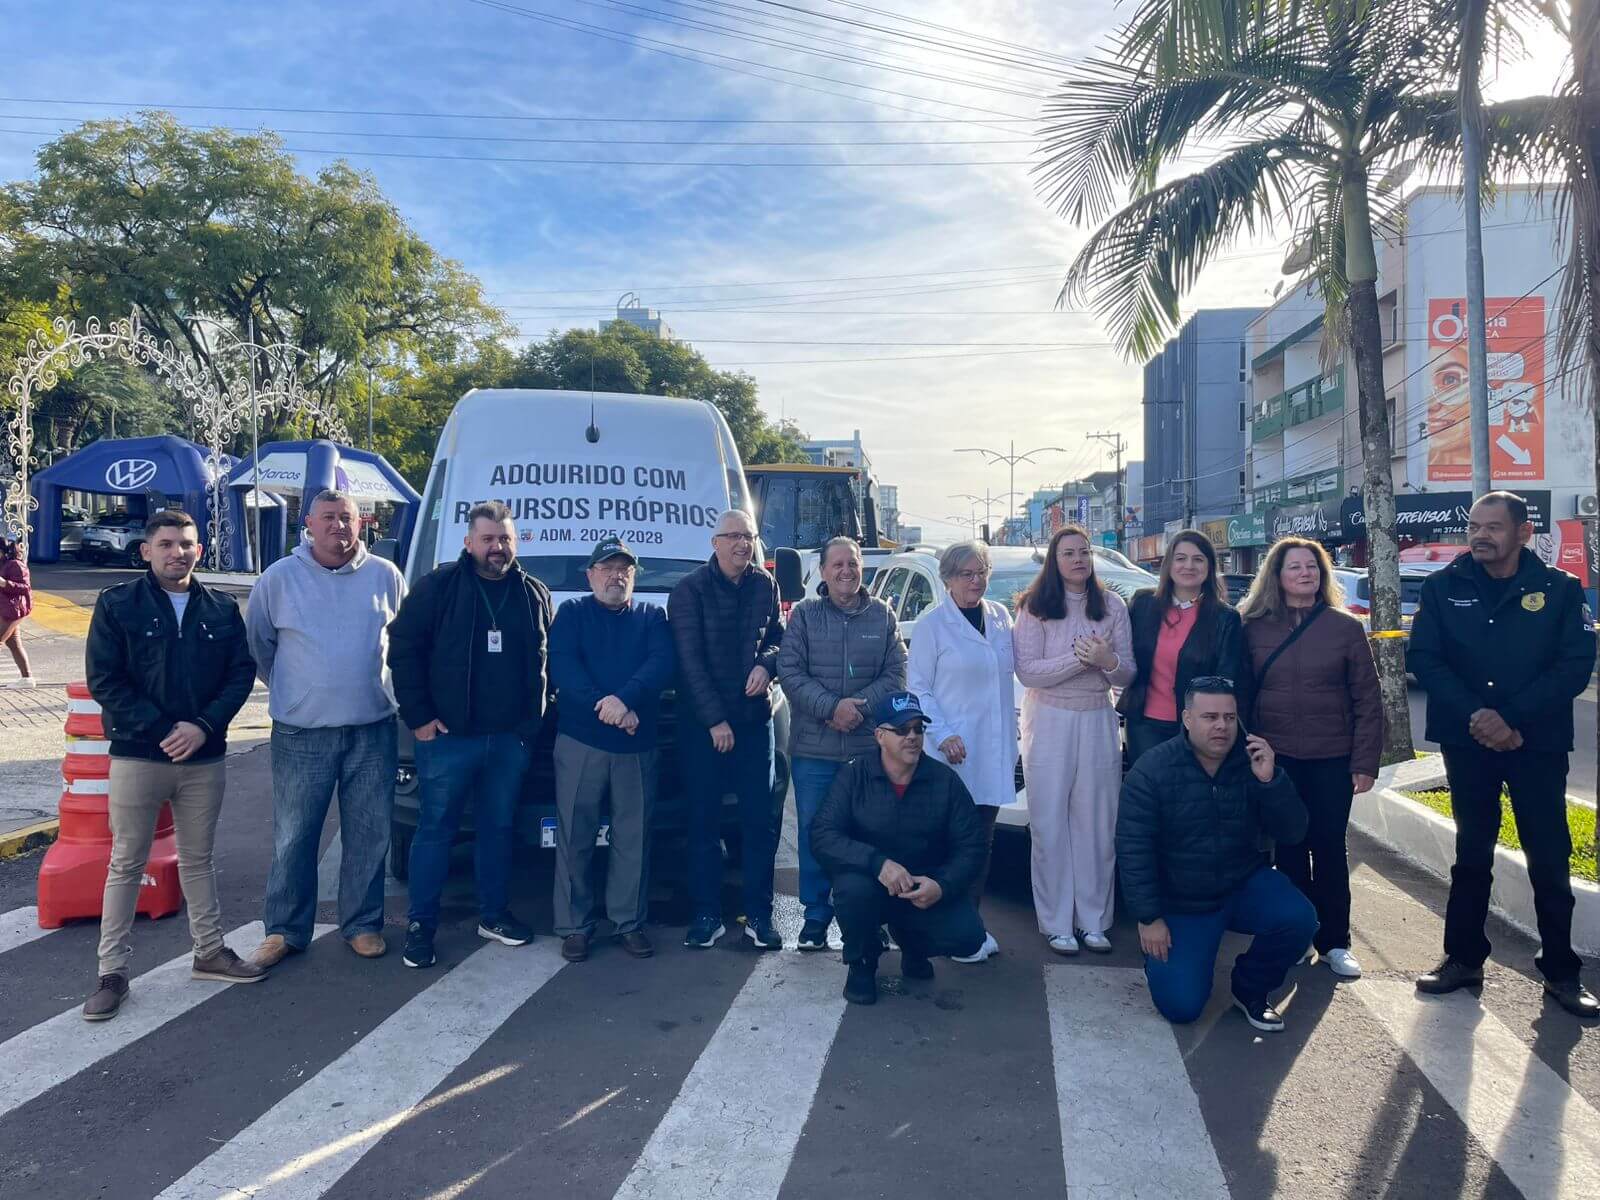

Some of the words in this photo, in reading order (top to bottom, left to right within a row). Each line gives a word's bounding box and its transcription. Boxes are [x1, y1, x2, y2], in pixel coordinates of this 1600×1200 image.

[490, 463, 626, 486] ADQUIRIDO
[633, 466, 688, 490] COM
[454, 497, 591, 524] RURSOS
[598, 496, 719, 529] PRÓPRIOS
[1396, 509, 1451, 525] TREVISOL
[539, 529, 576, 542] ADM.
[580, 528, 664, 544] 2025/2028
